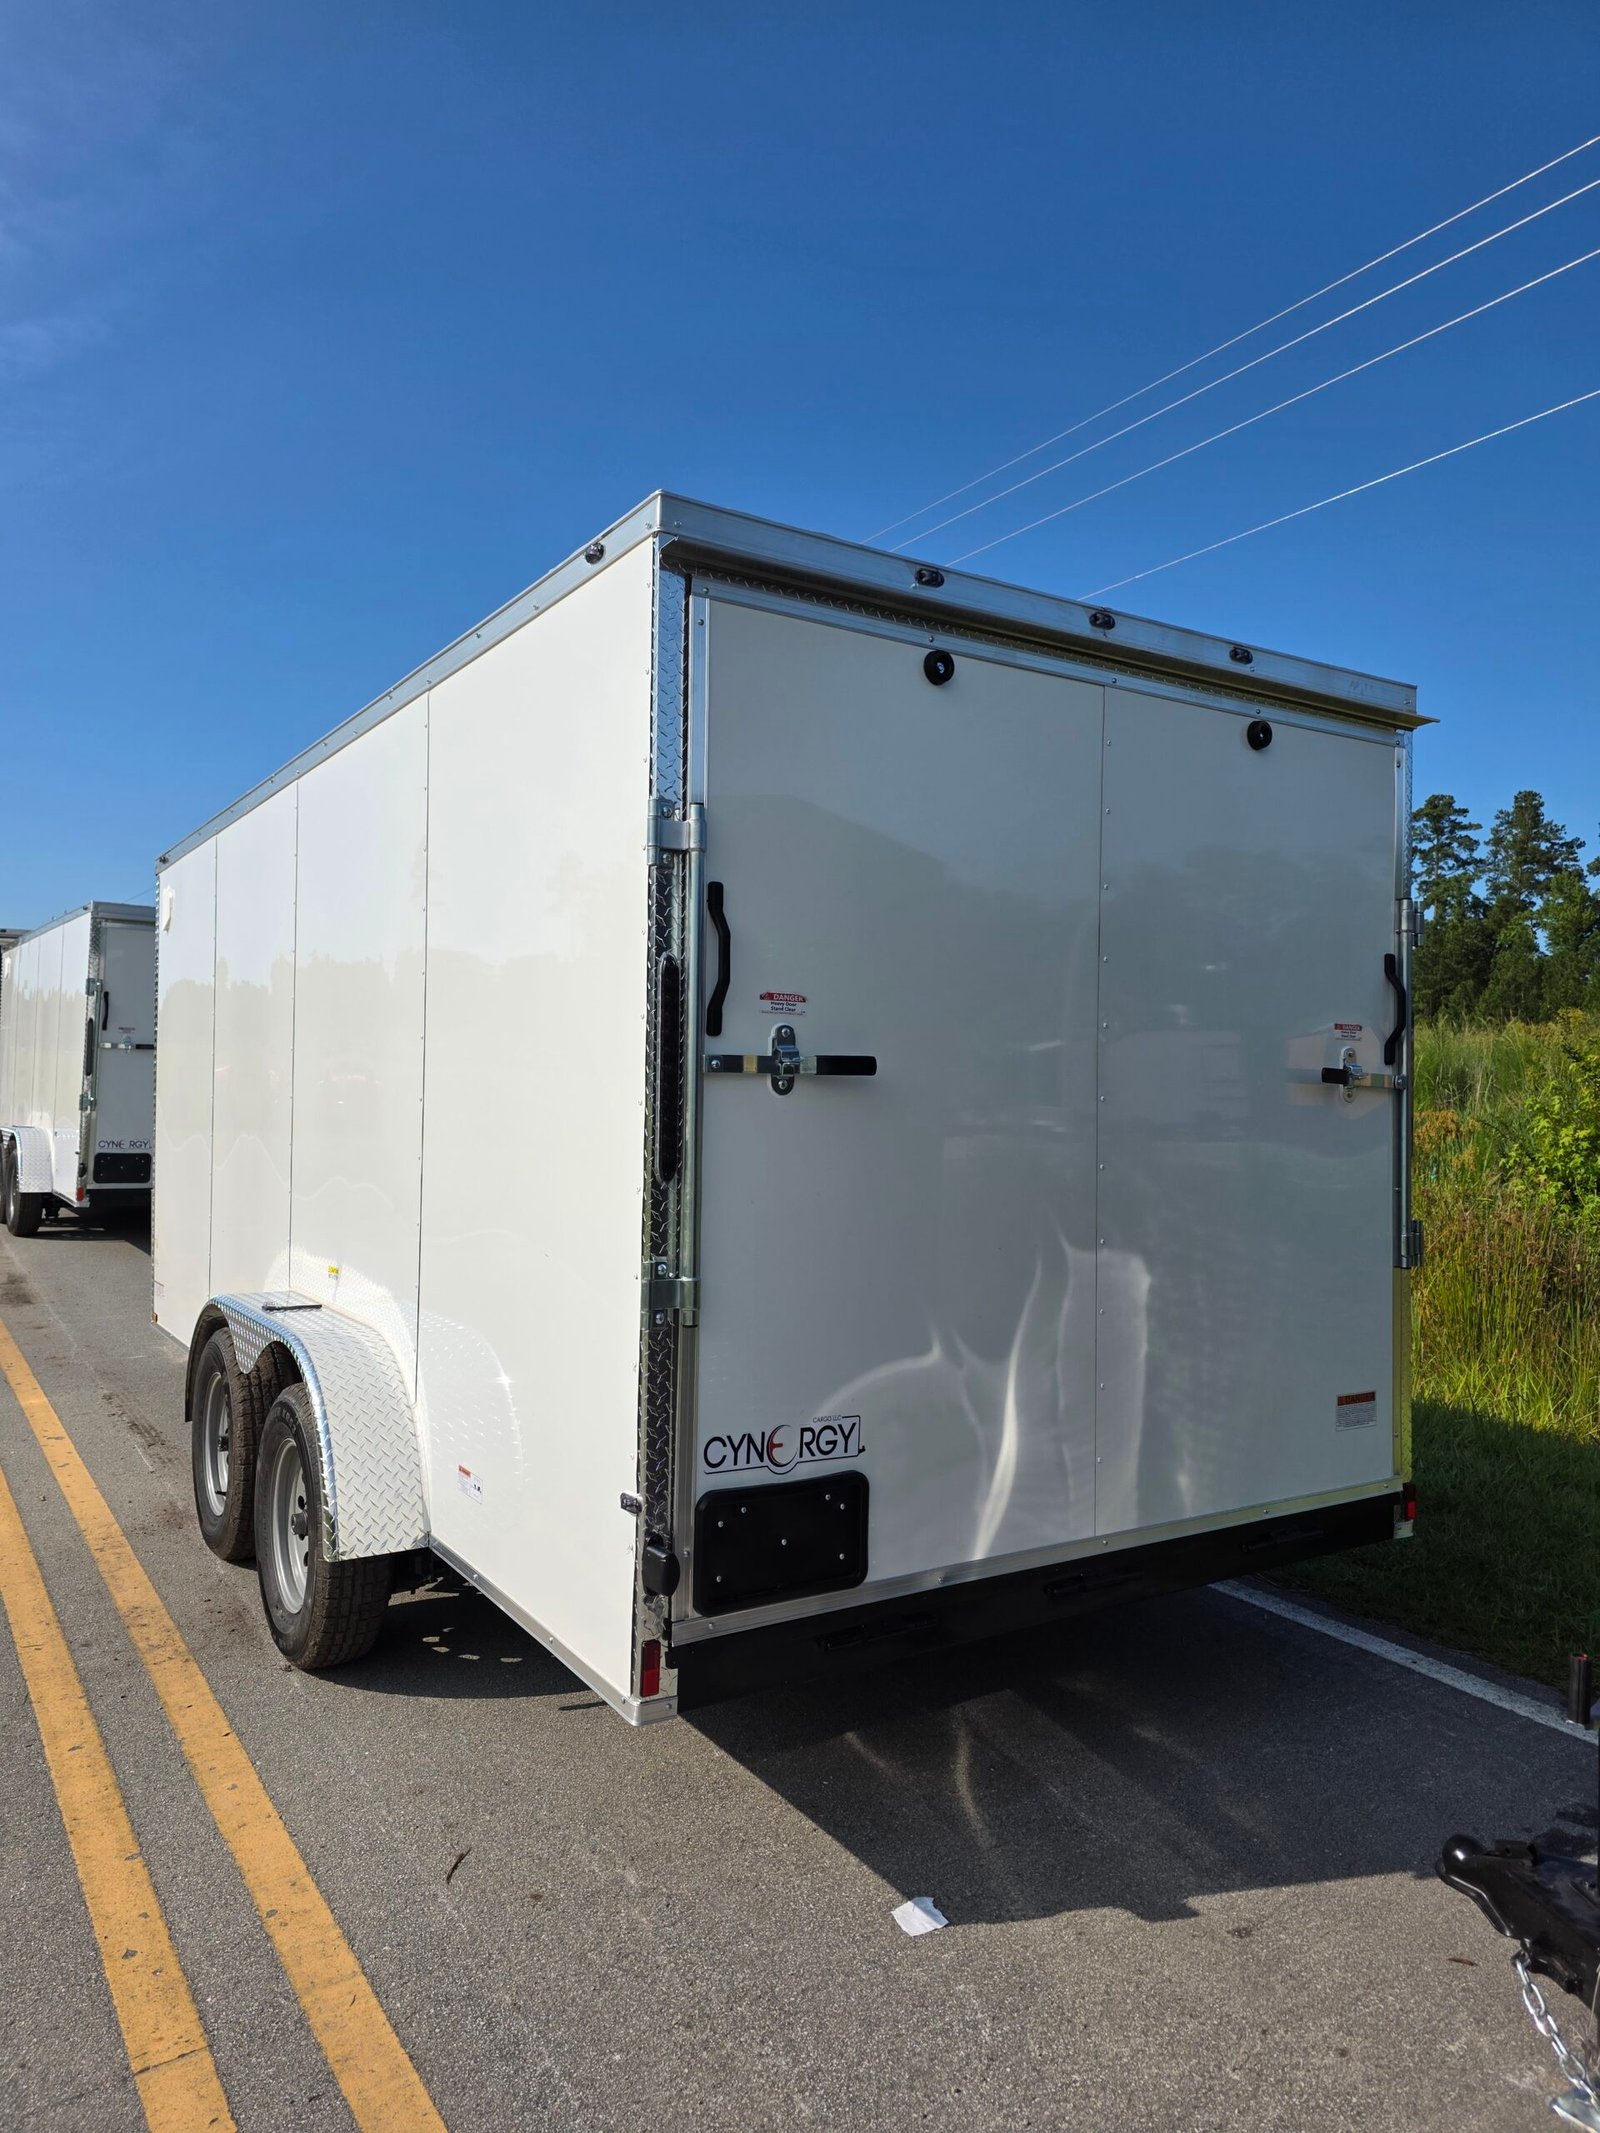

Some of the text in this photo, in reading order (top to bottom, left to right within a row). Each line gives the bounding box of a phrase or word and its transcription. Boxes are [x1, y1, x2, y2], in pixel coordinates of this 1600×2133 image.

[773, 993, 804, 1003] DANGER
[98, 1139, 150, 1150] CYNERGY
[703, 1422, 857, 1468] CYNERGY
